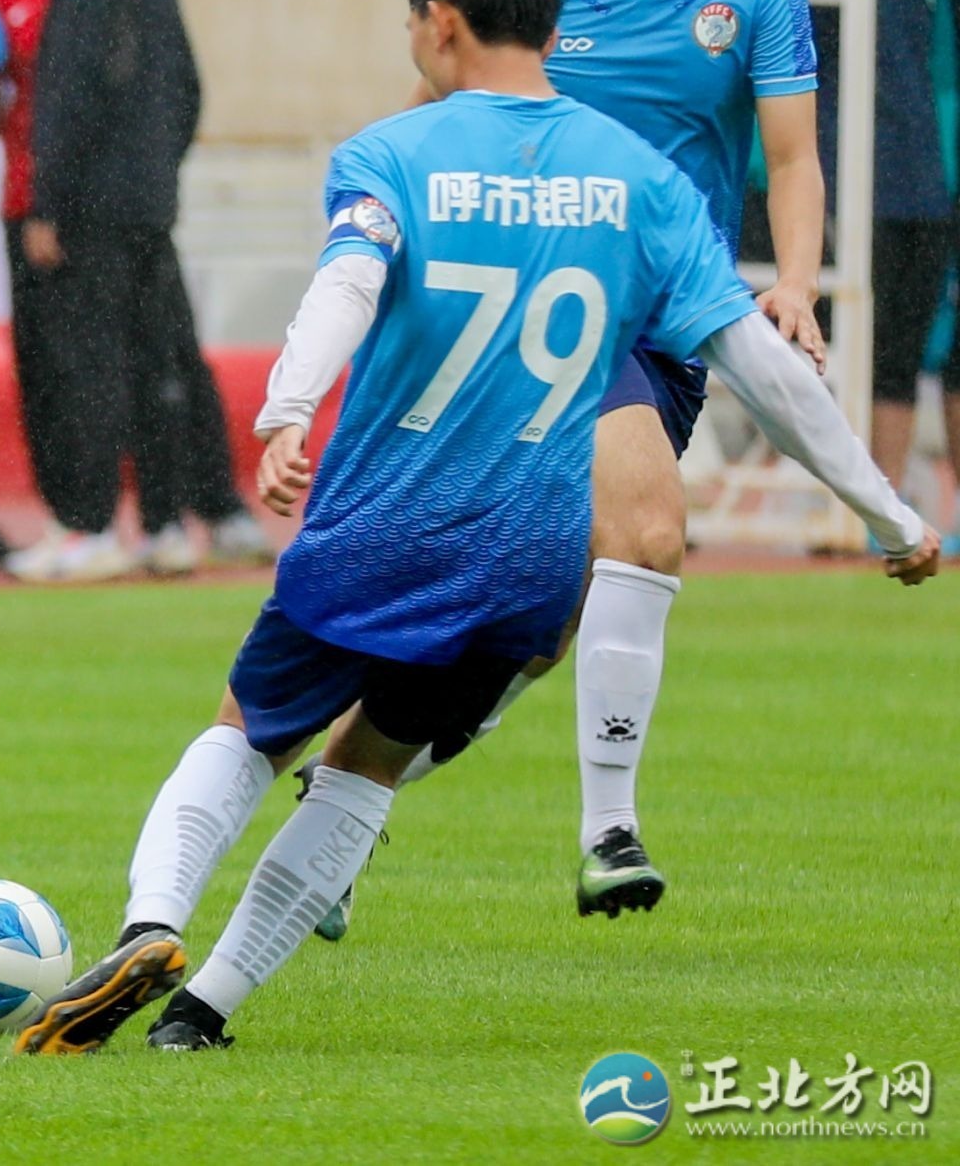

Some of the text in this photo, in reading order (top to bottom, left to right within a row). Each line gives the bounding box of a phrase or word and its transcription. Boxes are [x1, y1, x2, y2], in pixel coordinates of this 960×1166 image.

[427, 171, 628, 232] 呼市银风
[397, 260, 607, 443] 79
